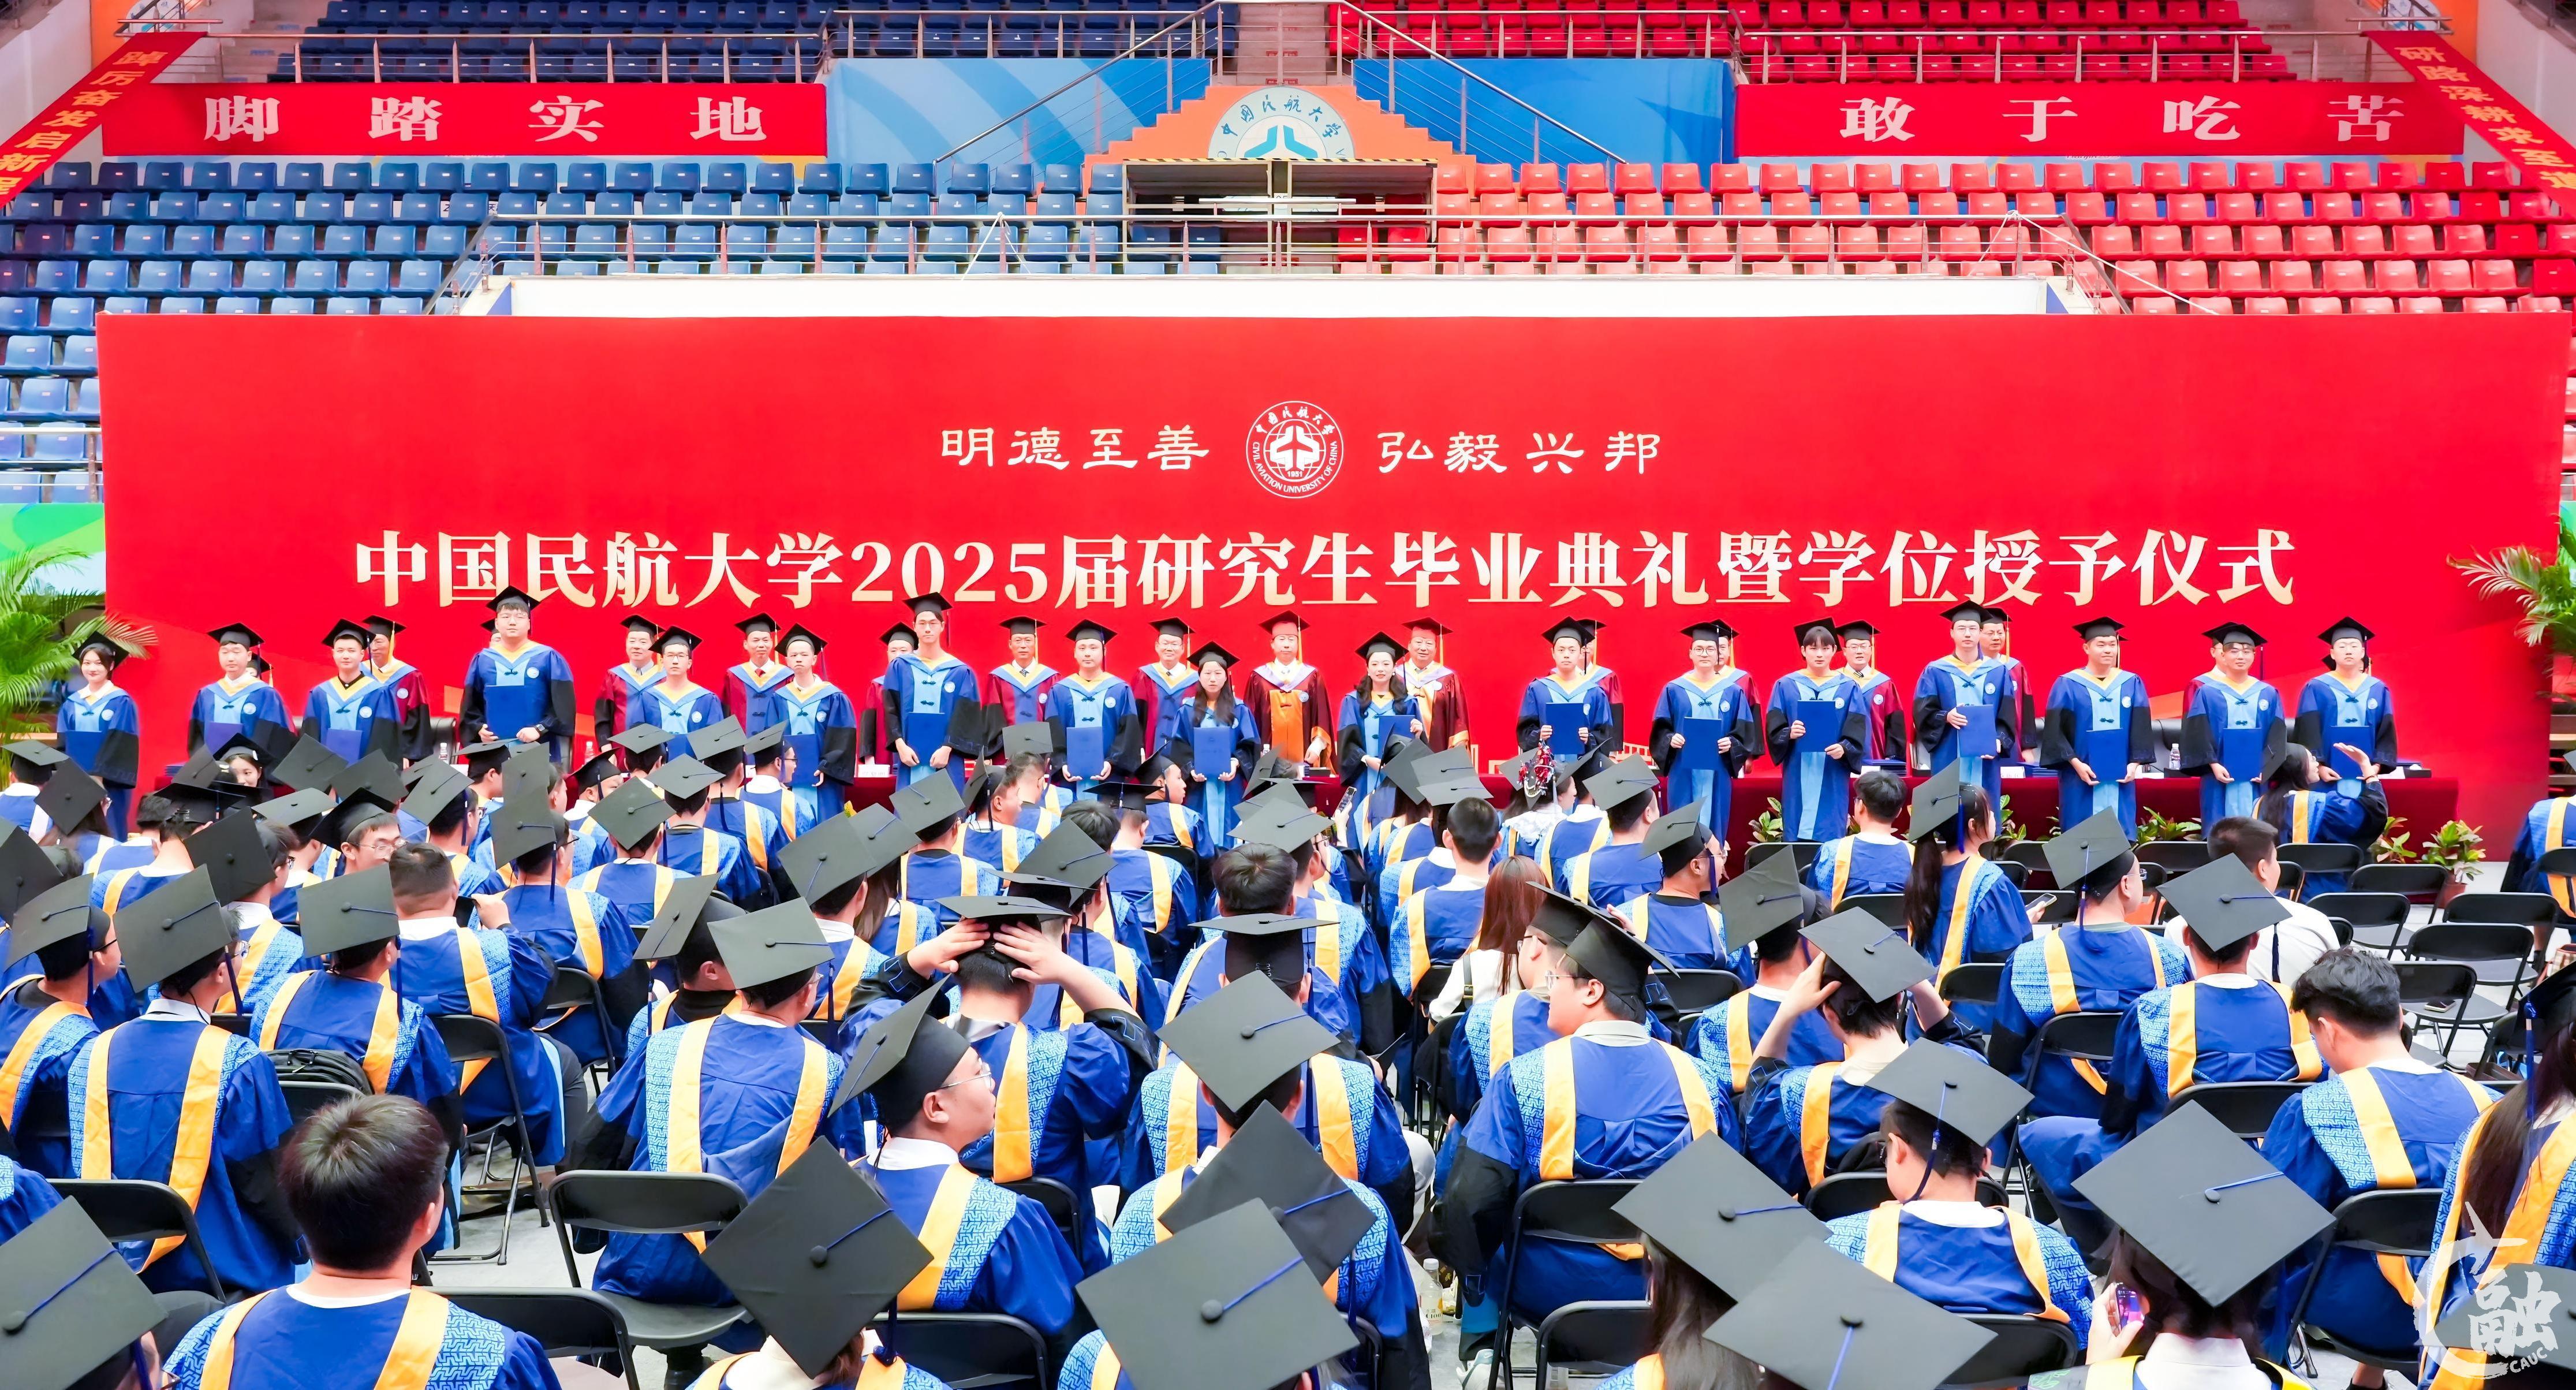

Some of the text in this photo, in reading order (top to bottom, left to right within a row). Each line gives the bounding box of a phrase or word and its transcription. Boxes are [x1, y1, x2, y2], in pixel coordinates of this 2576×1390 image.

[206, 96, 767, 142] 脚踏实地
[1222, 94, 1342, 138] 中国民航大学
[1840, 95, 2405, 142] 敢于吃苦
[1255, 405, 1335, 435] 中国民航大学
[942, 424, 1209, 471] 明德至善
[1252, 441, 1338, 494] CIVIL AVIATION UNIVERSITY OF CHINA
[1377, 431, 1660, 475] 弘毅兴邦
[356, 528, 2295, 608] 中国民航大学2025届研究生毕业典礼暨学位授予仪式
